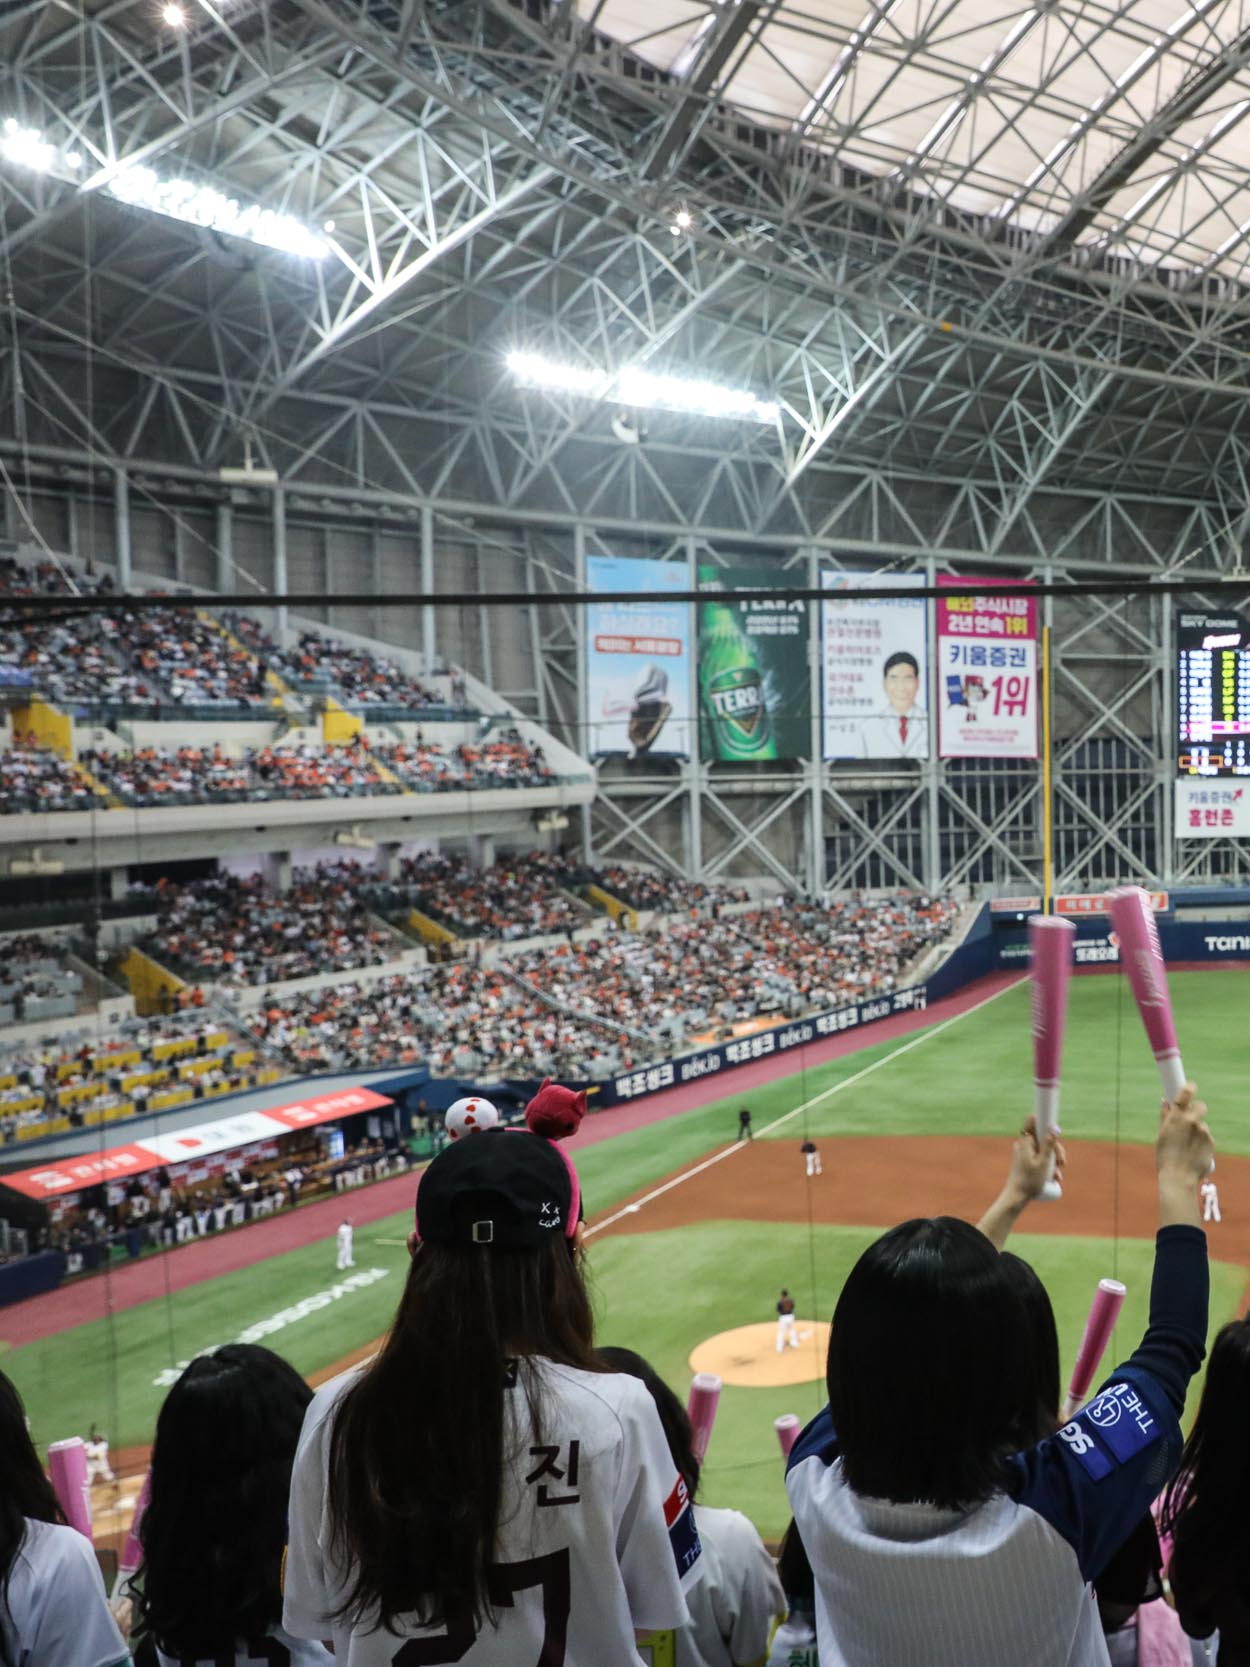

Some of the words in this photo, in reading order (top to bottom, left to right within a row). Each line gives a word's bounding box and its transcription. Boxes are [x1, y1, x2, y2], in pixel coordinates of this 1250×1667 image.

[950, 644, 1027, 668] 키움증권
[710, 685, 763, 716] TERR
[992, 675, 1030, 717] 1위
[1121, 1390, 1155, 1434] THE
